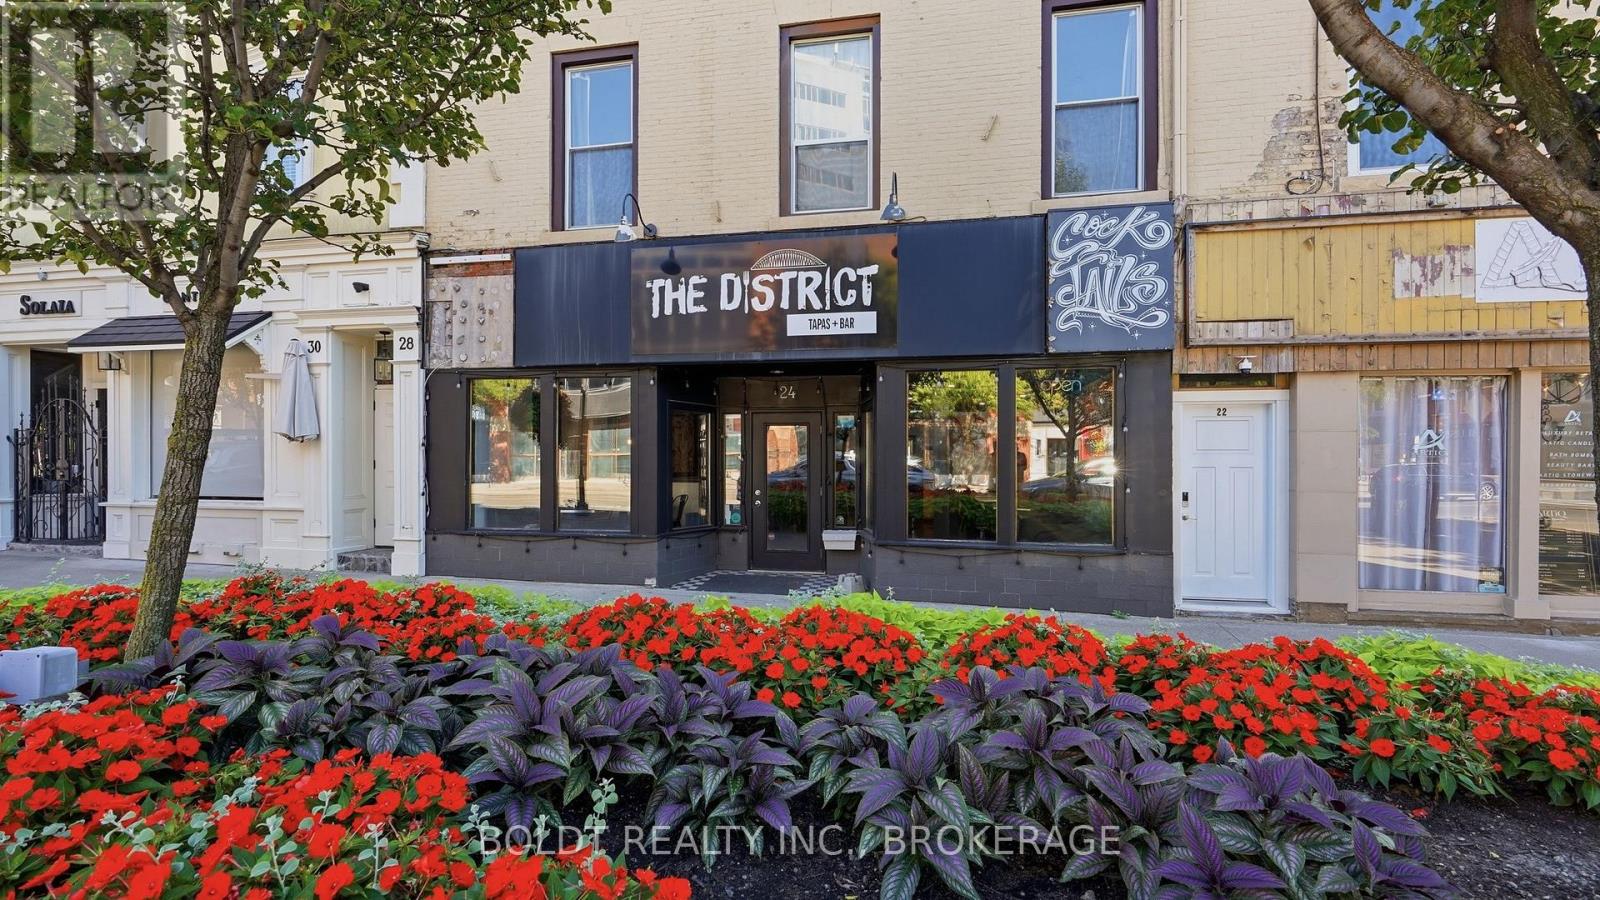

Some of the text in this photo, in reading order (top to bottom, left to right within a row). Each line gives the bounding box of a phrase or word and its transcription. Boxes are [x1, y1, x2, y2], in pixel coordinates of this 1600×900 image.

[646, 264, 879, 318] THE DISTRICT
[808, 318, 831, 330] TAPAS
[839, 317, 855, 329] BAR
[307, 340, 322, 354] 30
[398, 337, 415, 351] 28
[780, 385, 796, 399] 24
[1040, 379, 1082, 394] open
[1216, 407, 1227, 417] 22
